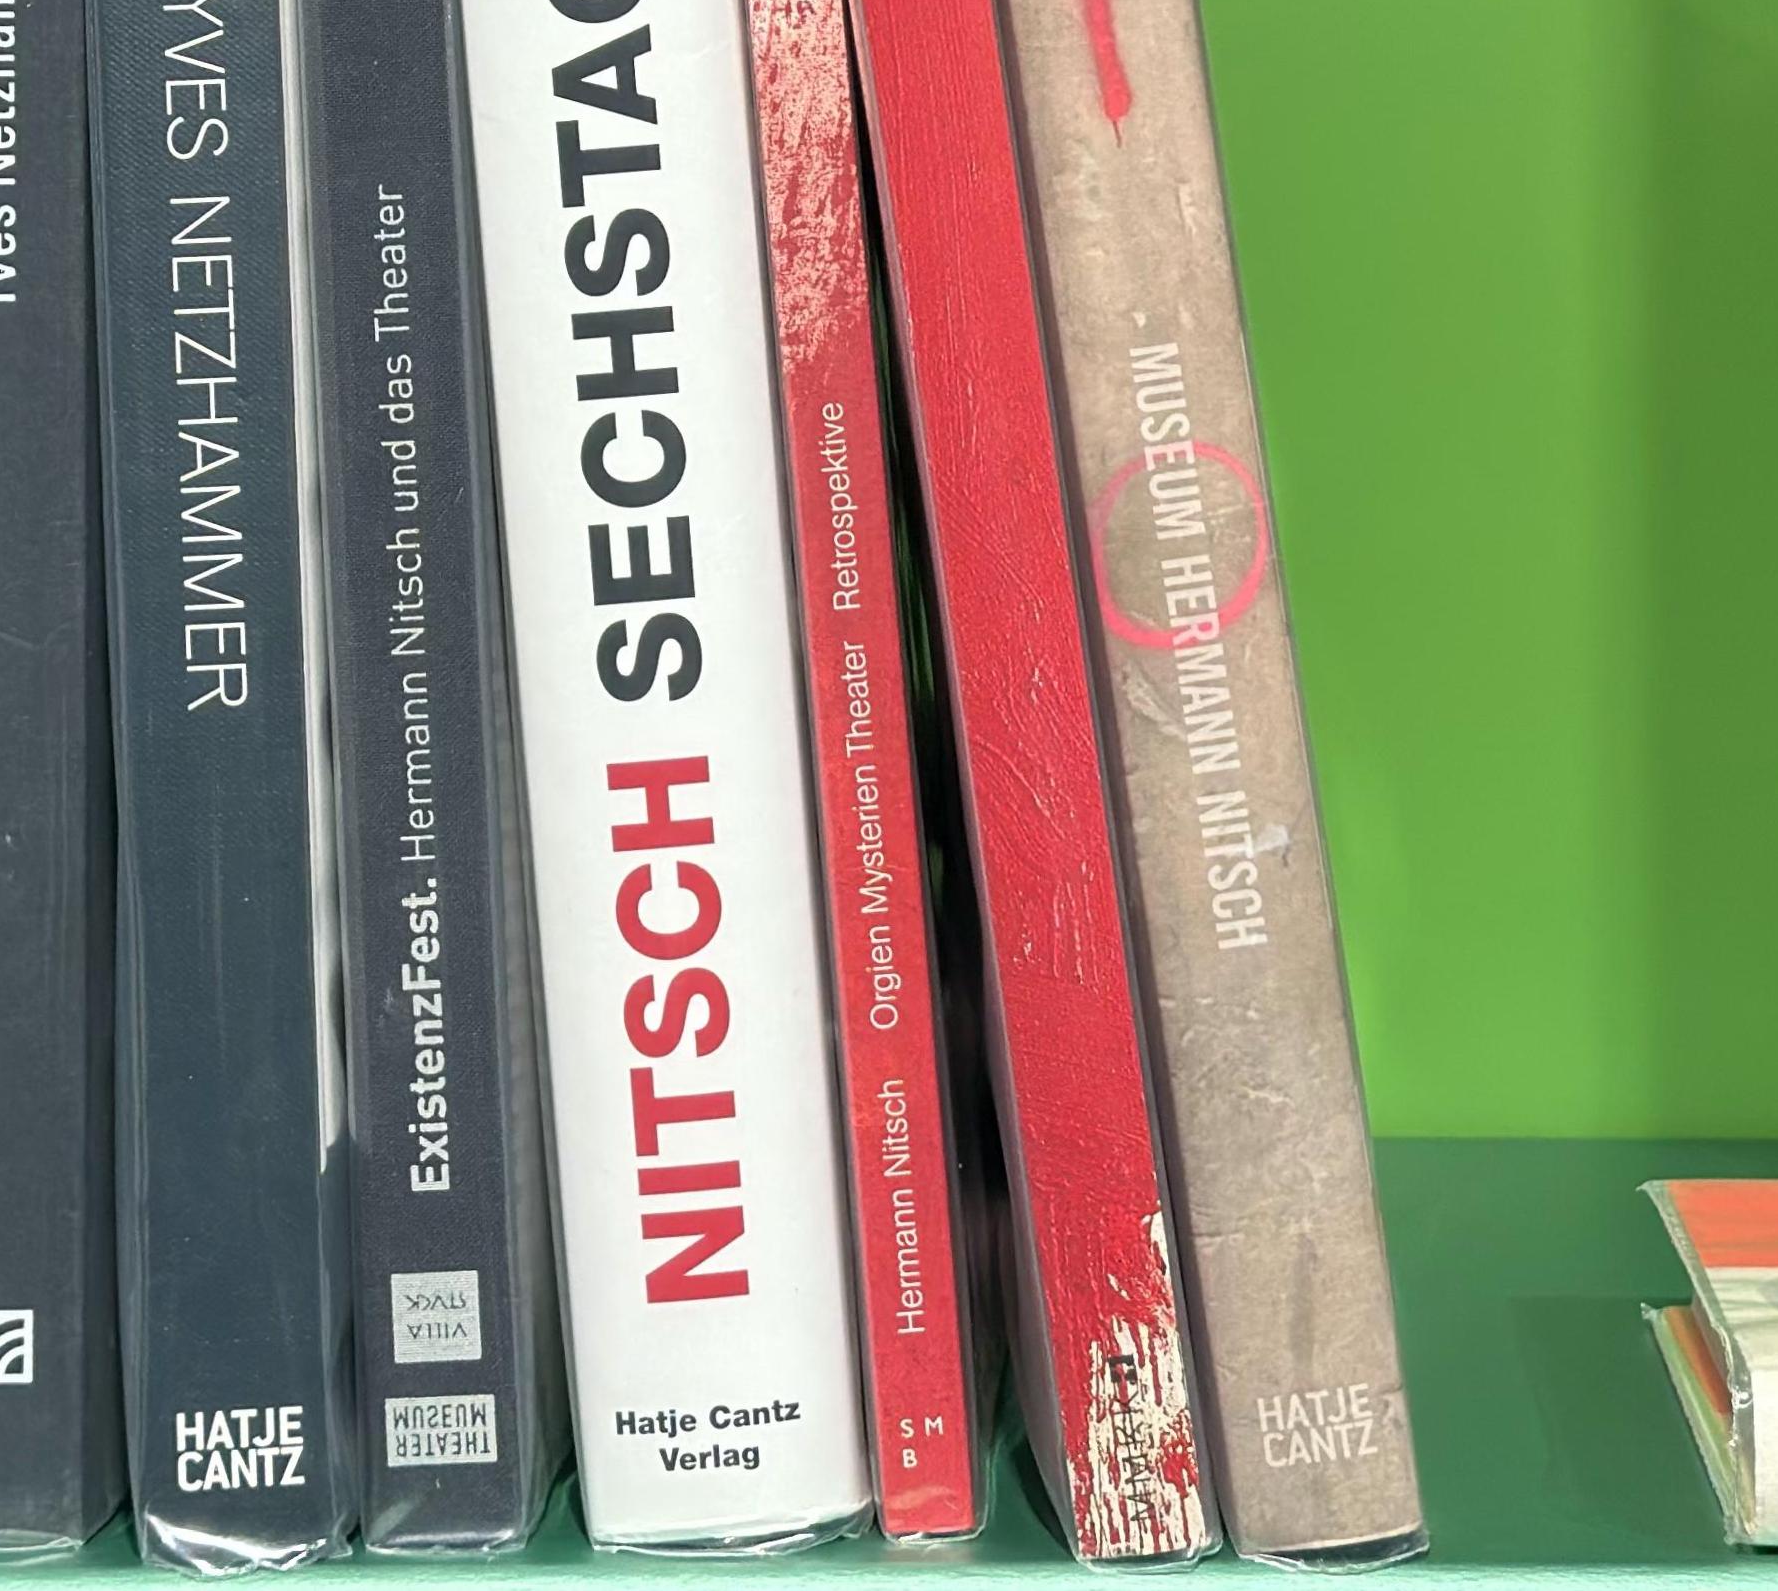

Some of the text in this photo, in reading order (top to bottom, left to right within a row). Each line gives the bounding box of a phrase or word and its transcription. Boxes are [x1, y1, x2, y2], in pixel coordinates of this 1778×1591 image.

[169, 195, 248, 711] NETZHAMMER
[1129, 342, 1268, 950] MUSEUM HERMANN NITSCH
[374, 185, 450, 1192] ExistenzFest. Hermann Nitsch und das Theater
[822, 402, 923, 1336] Hermann Nitsch Orgien Mysterien Theater Retrospektive
[606, 755, 750, 1304] NITSCH
[407, 1322, 467, 1339] VILLA
[176, 1405, 303, 1452] HATJE
[393, 1403, 486, 1429] MUSEUM
[616, 1400, 801, 1438] Hatje Cantz
[1258, 1385, 1369, 1434] HATJE
[395, 1431, 491, 1457] THEATER
[660, 1442, 761, 1472] Verlag
[1263, 1425, 1378, 1469] CANTZ
[176, 1448, 306, 1494] CANTZ
